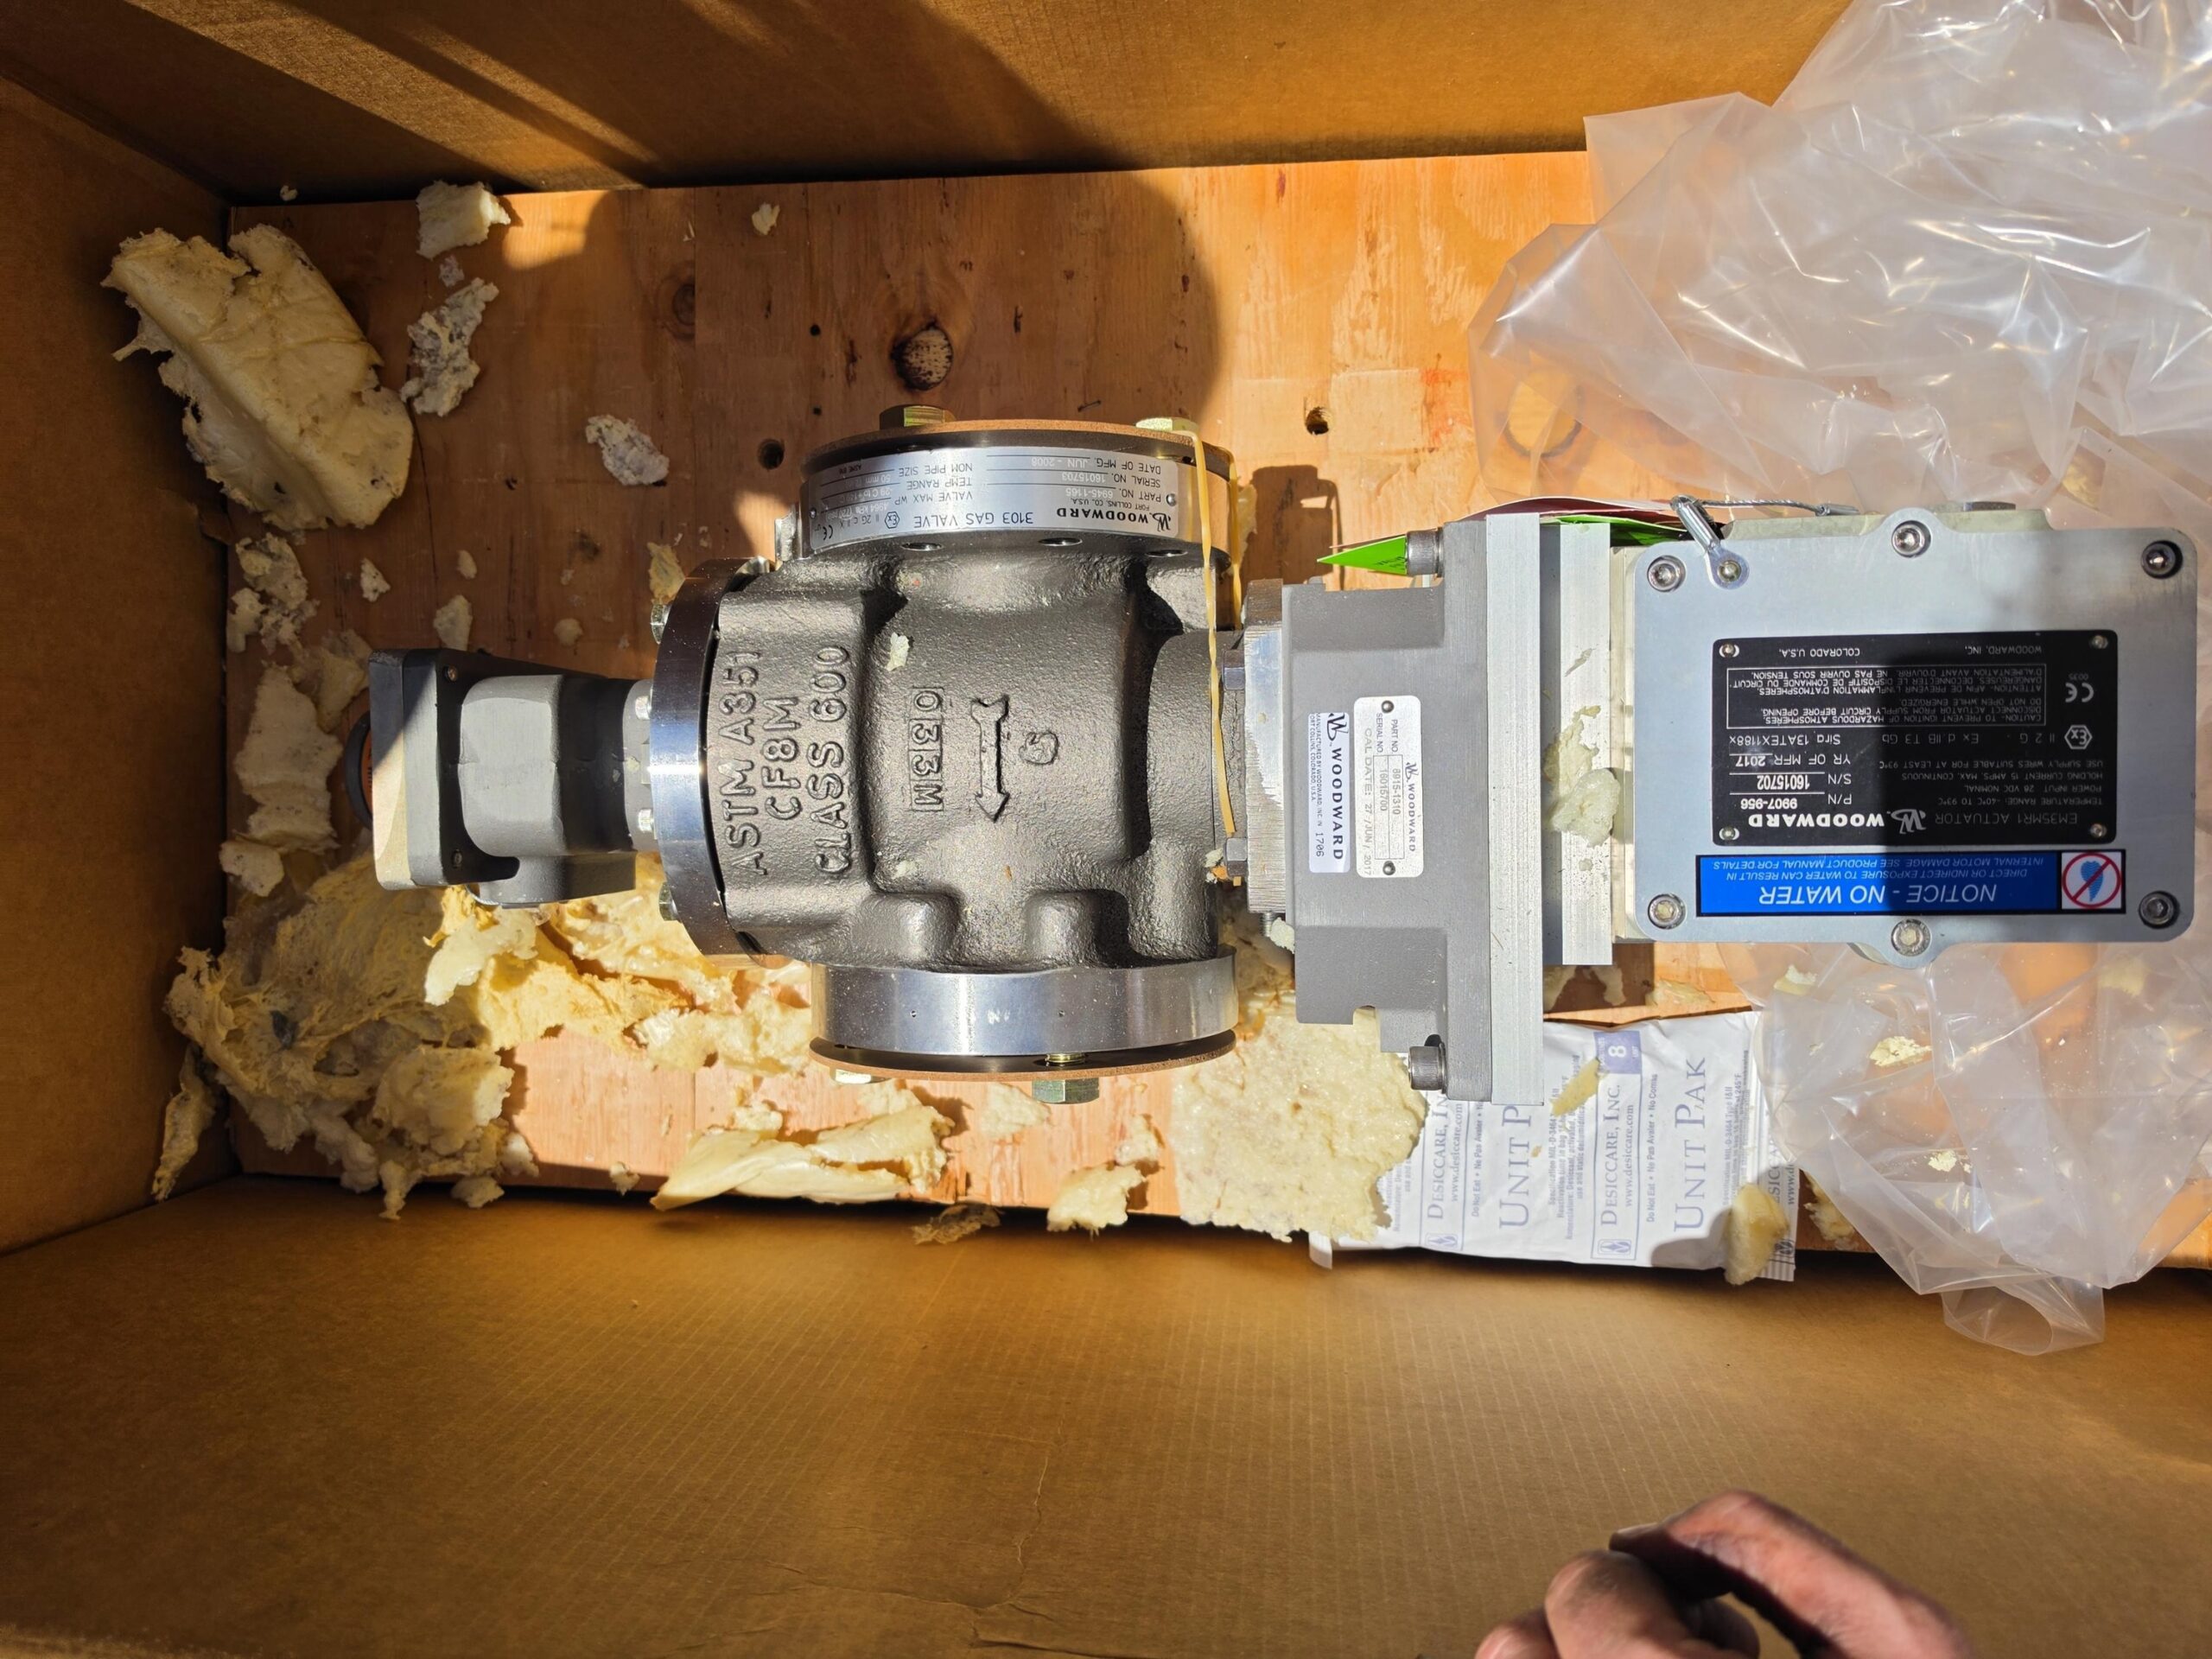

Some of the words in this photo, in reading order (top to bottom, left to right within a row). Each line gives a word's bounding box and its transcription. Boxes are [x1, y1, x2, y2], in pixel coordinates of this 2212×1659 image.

[951, 463, 972, 473] NOM
[1095, 458, 1116, 467] MFG.
[1121, 461, 1133, 470] OF
[1139, 462, 1160, 474] DATE
[899, 467, 918, 477] SIZE
[925, 465, 945, 474] PIPE
[945, 477, 971, 486] TEMP
[1062, 472, 1105, 483] 16015703
[1111, 474, 1126, 482] NO.
[1132, 476, 1160, 487] SERIAL
[906, 480, 939, 490] RANGE
[913, 493, 932, 503] MAX
[938, 491, 972, 501] VALVE
[1065, 487, 1113, 498] 6945-1165
[1119, 489, 1134, 498] NO.
[1139, 493, 1161, 502] PART
[894, 496, 907, 505] WP
[913, 515, 957, 528] VALVE
[966, 512, 994, 524] GAS
[1002, 512, 1033, 524] 3103
[1057, 508, 1147, 524] WOODWARD
[1810, 648, 1859, 657] COLORADO
[1854, 670, 1872, 678] PAS
[809, 645, 849, 722] 600
[718, 651, 760, 745] A351
[2065, 683, 2094, 702] CE
[1816, 734, 1840, 745] Sira
[1882, 734, 1898, 744] Gb
[1904, 734, 1919, 744] T3
[1962, 734, 1979, 743] Ex
[760, 697, 802, 820] CF8M
[1736, 756, 1765, 766] 2017
[1774, 755, 1801, 765] MFR
[1808, 754, 1826, 764] OF
[1834, 753, 1850, 764] YR
[1758, 775, 1809, 789] 16015702
[1827, 773, 1852, 784] S/N
[1332, 747, 1343, 860] WOODWARD
[1740, 798, 1797, 809] 9907-956
[1827, 794, 1852, 804] P/N
[806, 741, 850, 874] CLASS
[718, 758, 767, 875] ASTM
[1748, 813, 1885, 827] WOODWARD
[1935, 813, 2010, 824] ACTUATOR
[2017, 812, 2077, 824] EM35MR1
[1782, 860, 1823, 868] MANUAL
[1827, 859, 1878, 868] PRODUCT
[1880, 859, 1900, 868] SEE
[1994, 857, 2044, 866] INTERNAL
[1862, 870, 1918, 879] EXPOSURE
[1920, 869, 1968, 878] INDIRECT
[1988, 868, 2027, 877] DIRECT
[1759, 886, 1841, 904] WATER
[1850, 885, 1885, 903] NO
[1905, 885, 1996, 902] NOTICE
[1608, 1046, 1626, 1058] 8
[1675, 1058, 1706, 1128] PAK
[1603, 1085, 1620, 1122] INC.
[1648, 1100, 1656, 1110] No
[1449, 1103, 1463, 1202] www.desiccare.com
[1622, 1104, 1634, 1207] www.desiccare.com
[1427, 1125, 1449, 1219] DESICCARE,
[1600, 1127, 1620, 1225] DESICCARE,
[1499, 1137, 1530, 1229] UNIT
[1674, 1140, 1705, 1232] UNIT
[1647, 1212, 1655, 1223] Do
